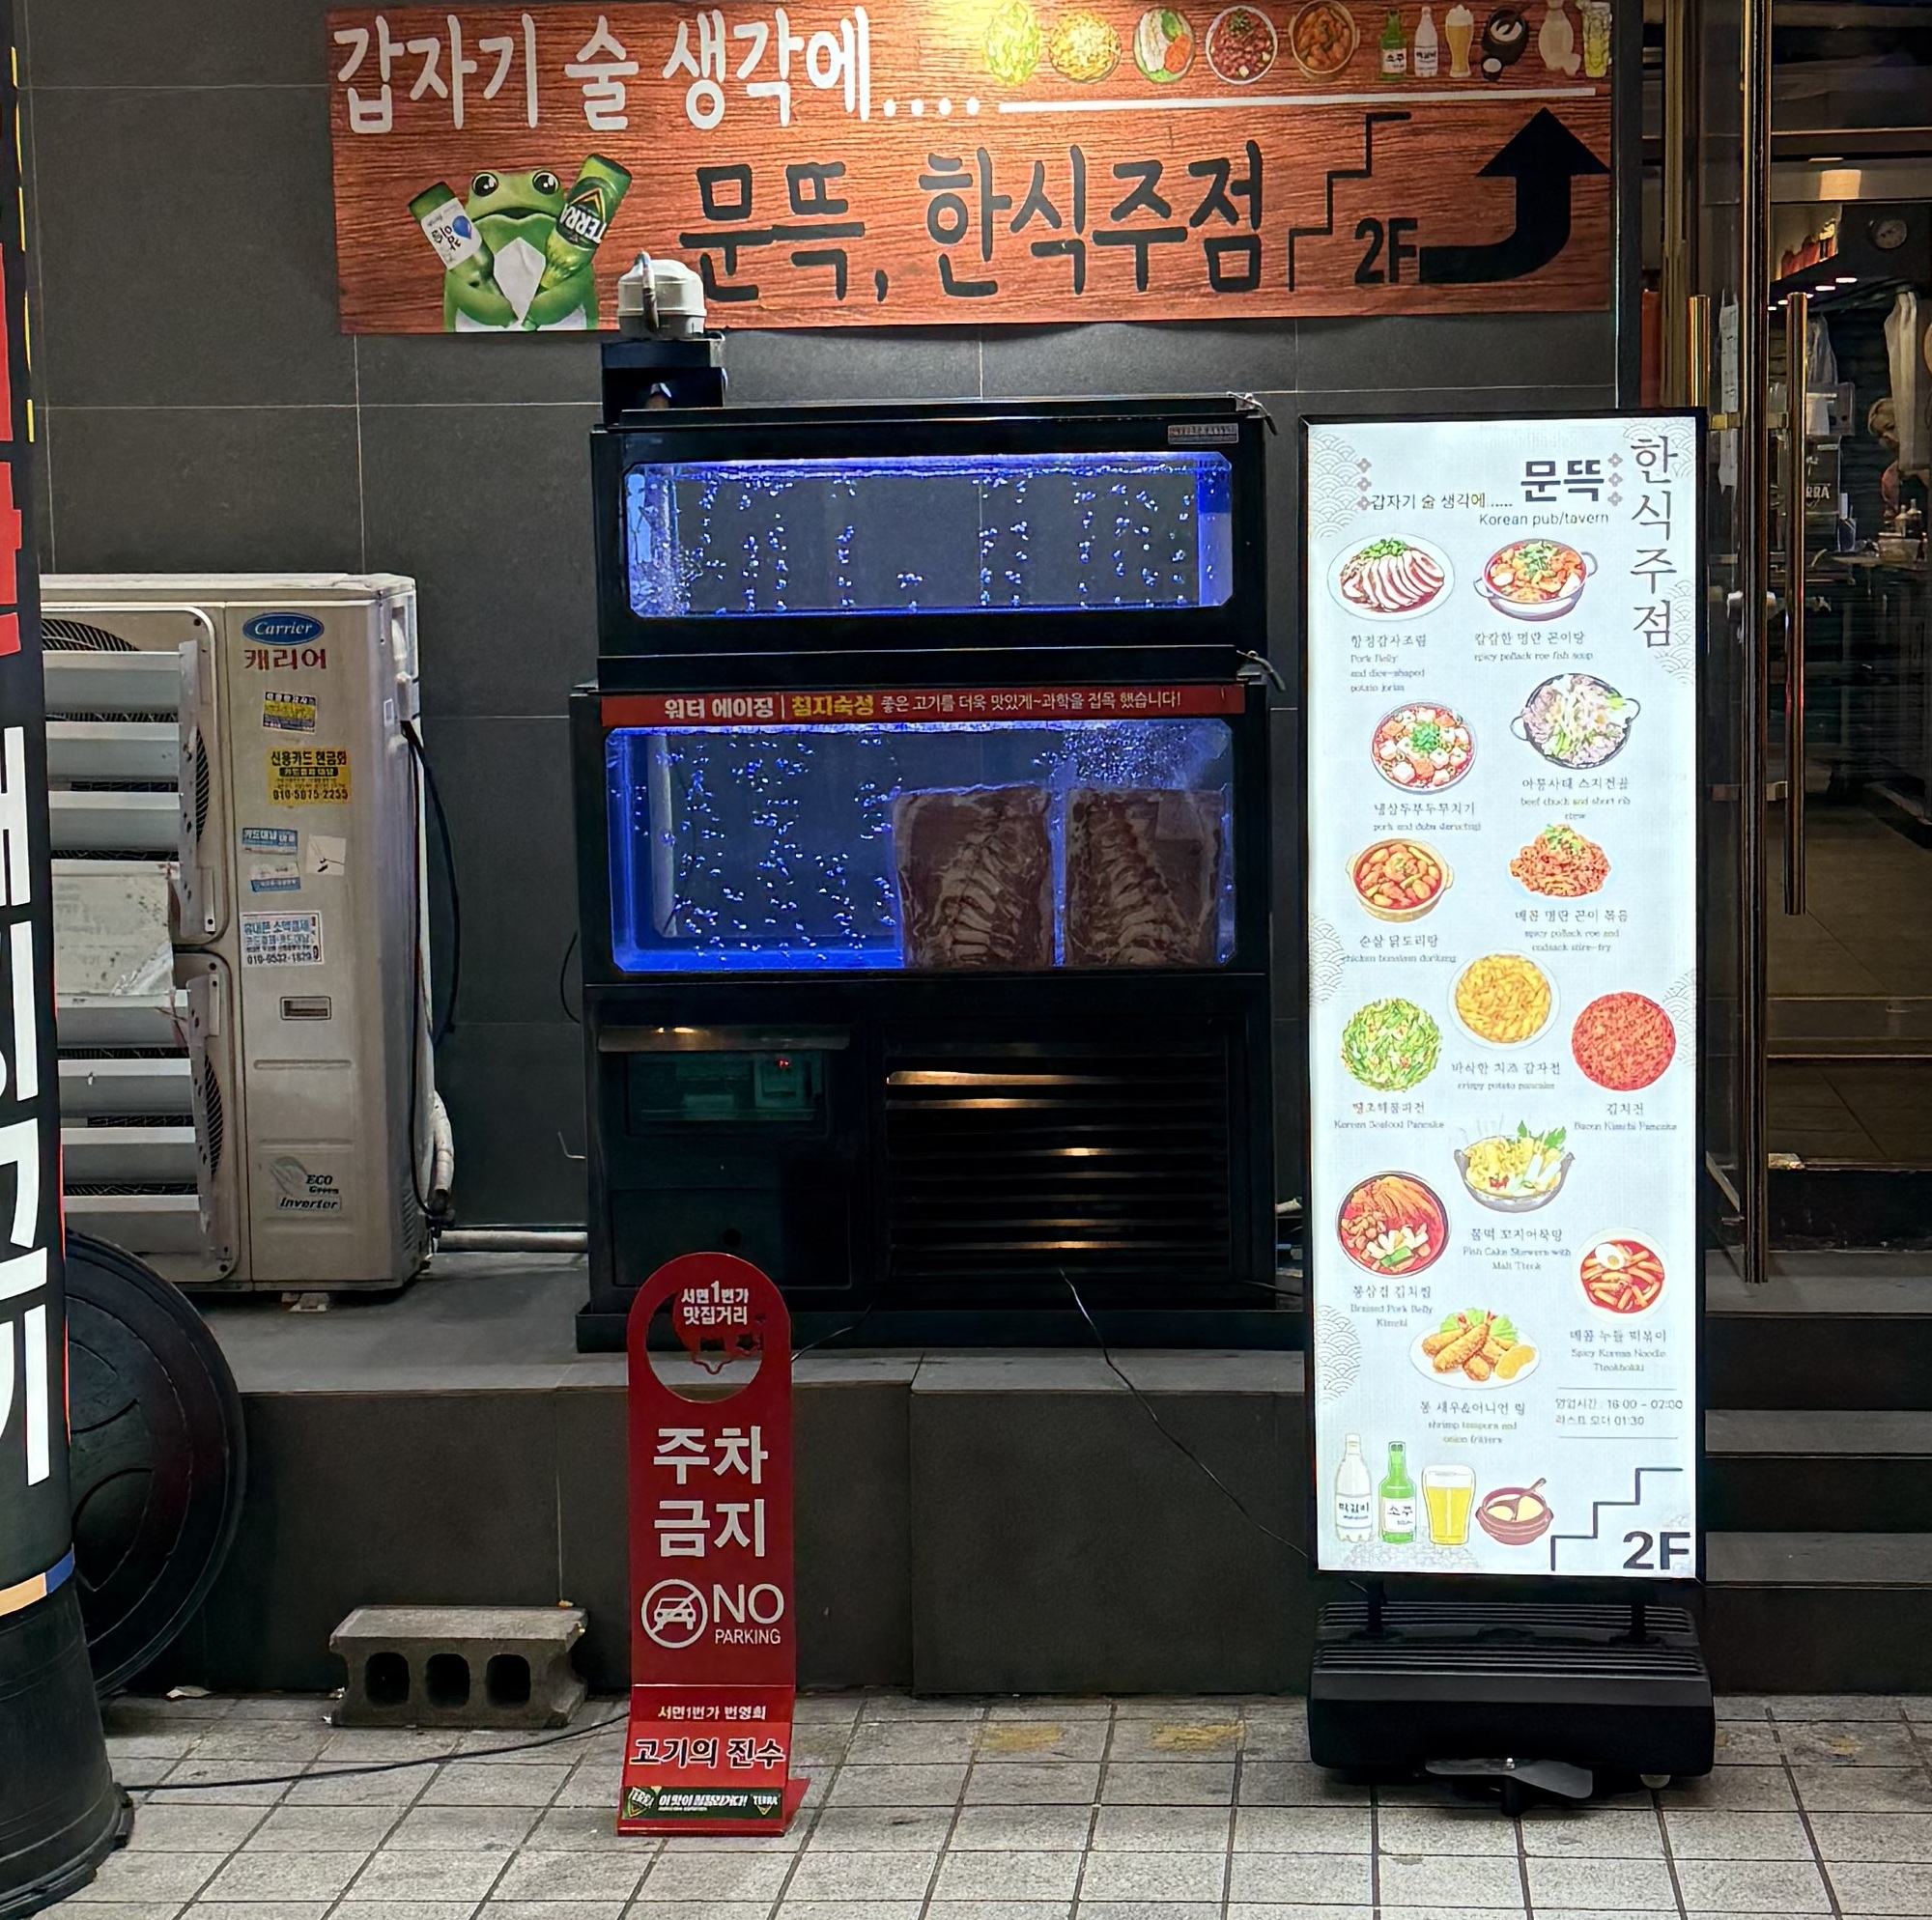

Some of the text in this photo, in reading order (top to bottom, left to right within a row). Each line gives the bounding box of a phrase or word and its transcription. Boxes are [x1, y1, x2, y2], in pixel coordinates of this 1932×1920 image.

[334, 14, 538, 133] 갑자기
[565, 14, 639, 130] 술
[558, 203, 608, 244] TERRA
[680, 140, 1263, 302] 문뜩, 한식주점
[1354, 216, 1419, 284] 2F
[1520, 460, 1605, 502] 문뜩
[1805, 486, 1830, 498] RRA
[1371, 494, 1415, 510] 갑자기
[1422, 494, 1436, 510] 술
[1480, 512, 1609, 527] Korean pub/tavern
[1631, 436, 1678, 648] 한식주점
[255, 621, 313, 635] Carrier
[244, 648, 327, 670] 캐리어
[1552, 651, 1570, 660] fish
[665, 698, 705, 720] 워터
[712, 696, 774, 719] 에이징
[791, 694, 873, 717] 침지숙성
[880, 695, 909, 714] 좋은
[913, 693, 955, 713] 고기를
[958, 693, 987, 712] 더욱
[1120, 691, 1181, 709] 했습니다!
[271, 750, 347, 766] 신용카드 현금화
[1520, 797, 1540, 805] beef
[1573, 797, 1588, 805] and
[1604, 929, 1619, 938] and
[1488, 1082, 1516, 1090] potato
[1334, 1120, 1366, 1129] Korean
[306, 1174, 333, 1185] ECO
[280, 1197, 337, 1209] Inverter
[681, 1280, 749, 1304] 서면1번가
[683, 1306, 748, 1325] 맛집거리
[1651, 1399, 1683, 1409] 02:00
[1614, 1416, 1645, 1426] 01:30
[653, 1426, 769, 1485] 주차
[1387, 1506, 1413, 1516] 소주
[653, 1498, 767, 1558] 금지
[1622, 1531, 1691, 1570] 2F
[713, 1582, 785, 1625] NO
[714, 1628, 781, 1645] PARKING
[658, 1706, 766, 1720] 서면1번가 번영회
[629, 1736, 786, 1769] 고기의 진수
[628, 1787, 655, 1808] TERRA
